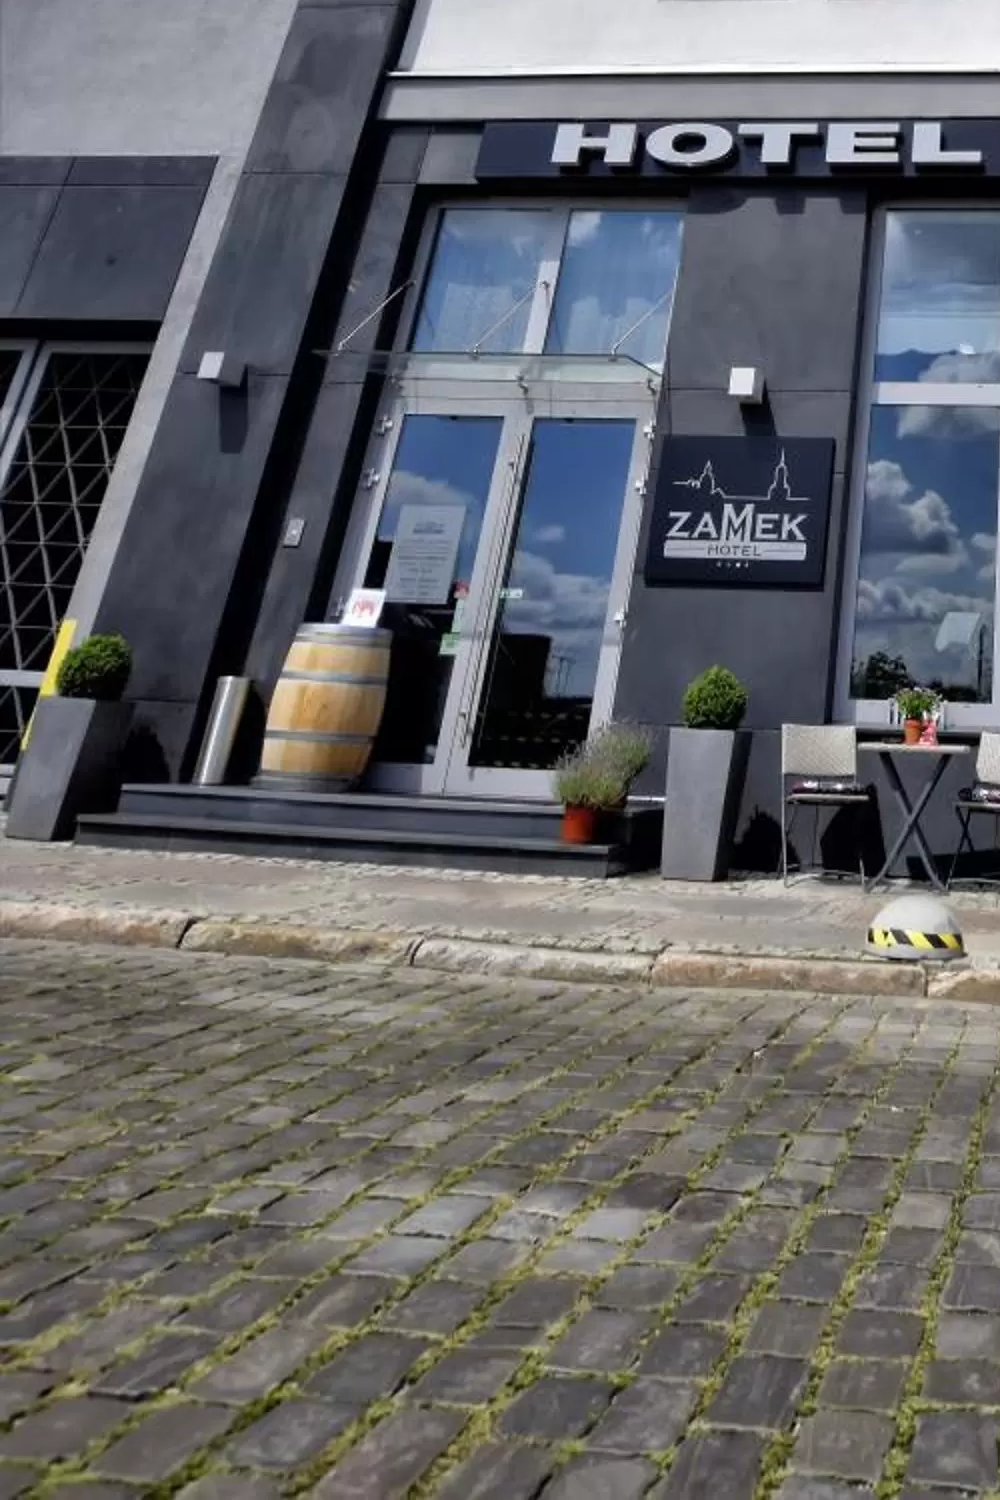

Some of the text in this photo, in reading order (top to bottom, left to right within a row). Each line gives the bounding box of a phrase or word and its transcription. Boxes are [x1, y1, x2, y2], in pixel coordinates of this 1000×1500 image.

[550, 123, 983, 167] HOTEL
[665, 503, 808, 542] ZAMEK
[706, 545, 763, 558] HOTEL
